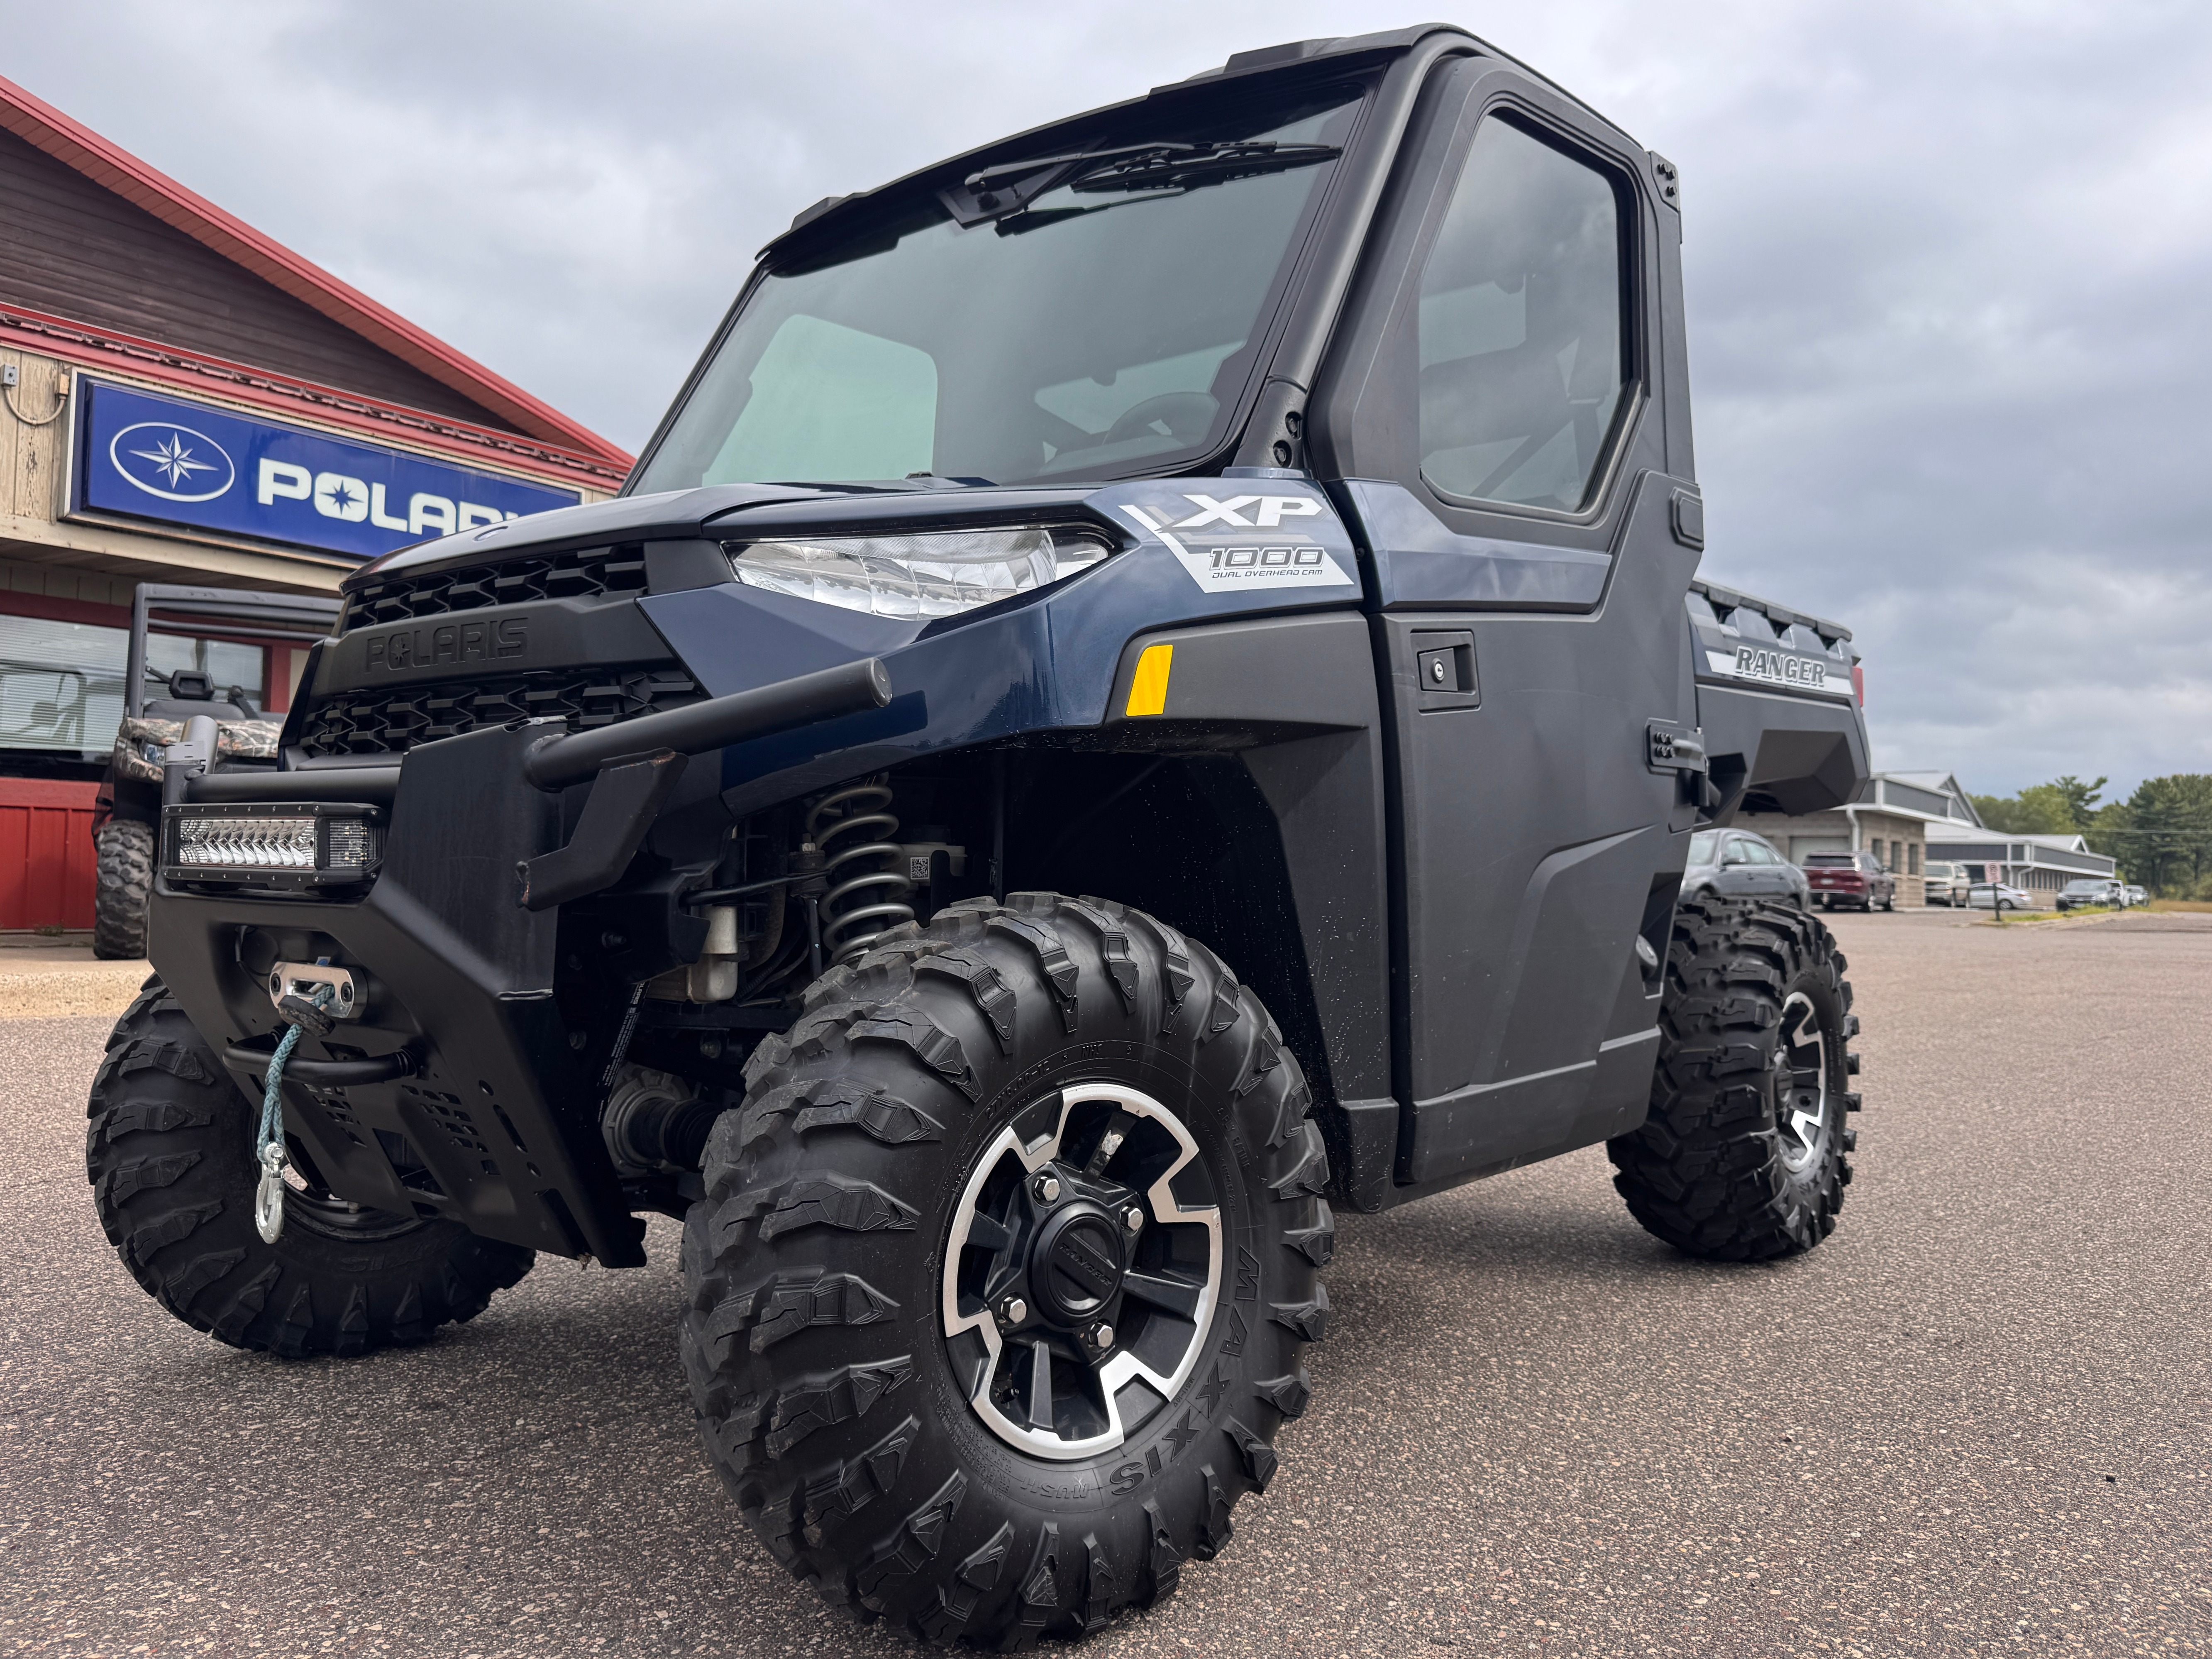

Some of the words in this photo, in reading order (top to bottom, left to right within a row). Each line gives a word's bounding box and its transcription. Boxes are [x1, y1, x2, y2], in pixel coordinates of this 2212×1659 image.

[258, 458, 518, 536] POLAR
[1171, 494, 1323, 527] XP
[1209, 547, 1324, 570] 1000
[365, 617, 529, 674] POLARIS
[1735, 646, 1825, 686] RANGER
[1060, 1242, 1112, 1286] RANGER
[1109, 1244, 1260, 1496] MAXXIS
